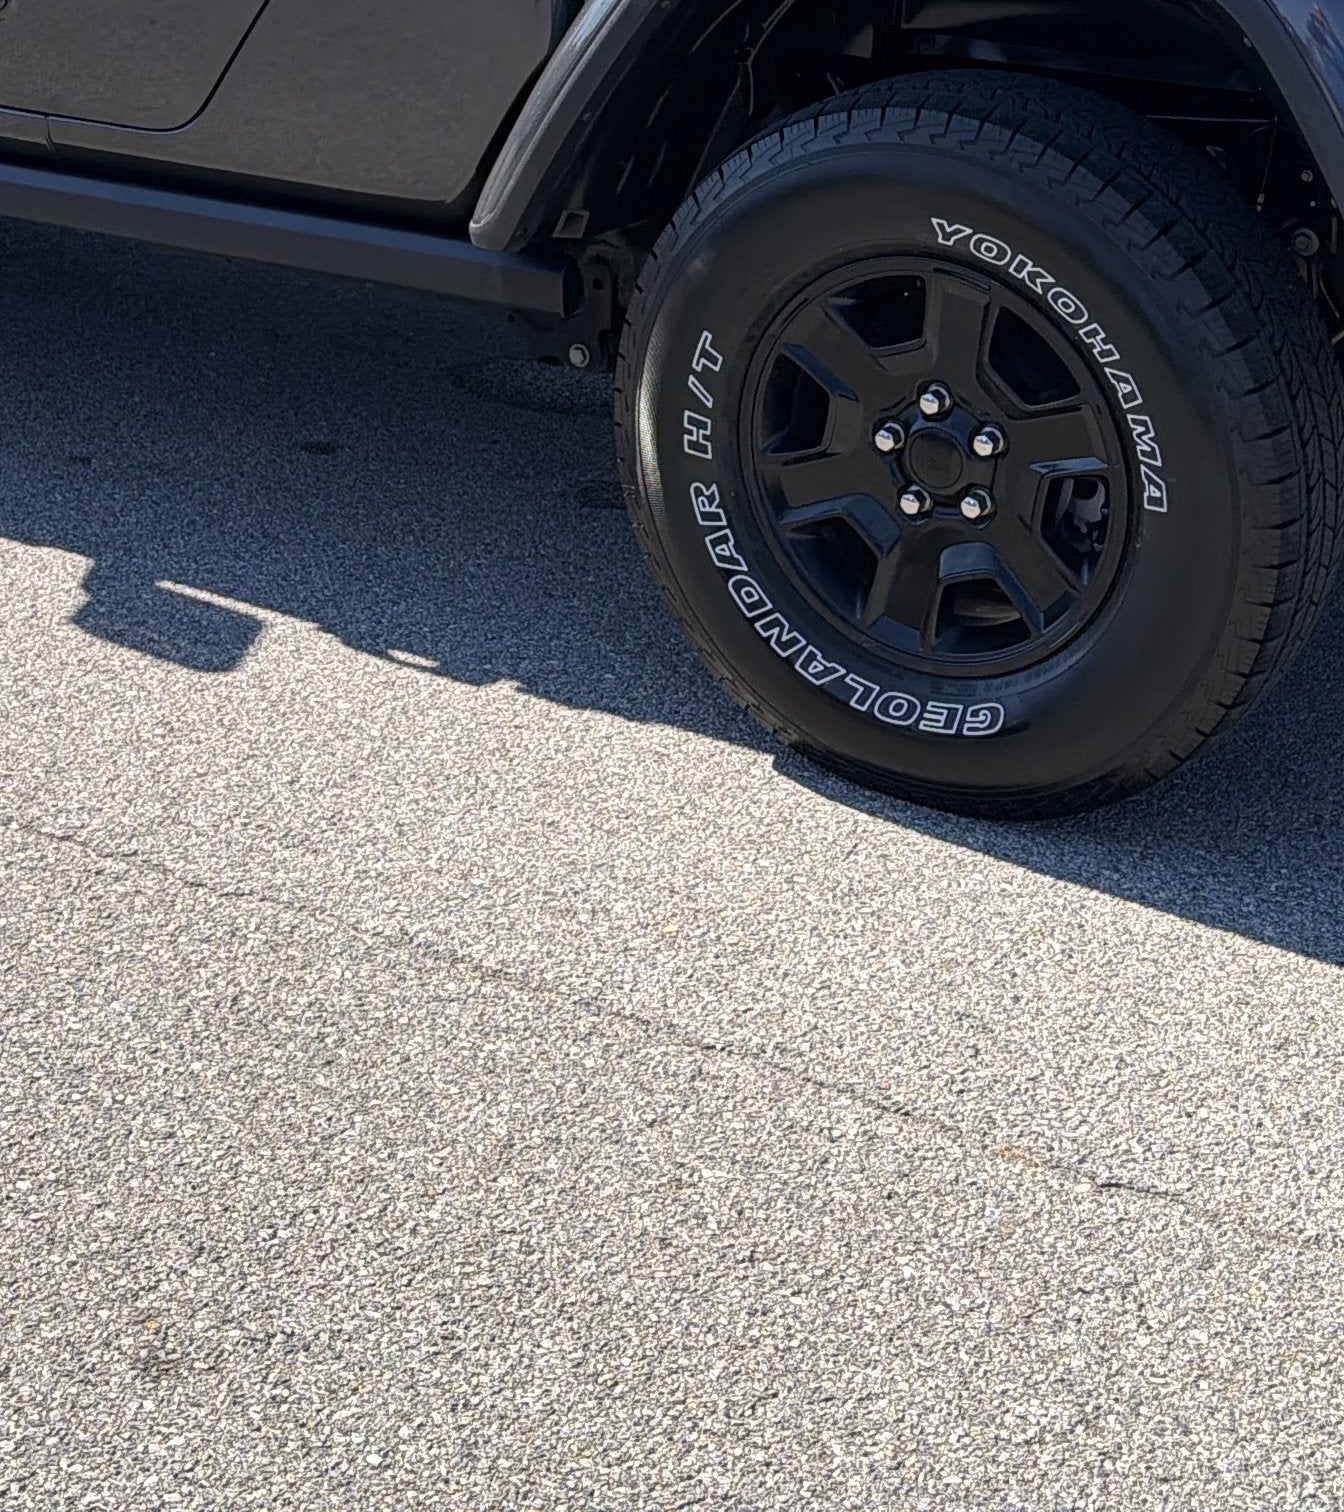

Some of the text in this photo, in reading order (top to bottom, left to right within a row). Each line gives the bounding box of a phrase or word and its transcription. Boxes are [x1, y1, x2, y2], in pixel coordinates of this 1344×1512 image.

[683, 330, 1005, 736] GEOLANDAR H/T
[931, 217, 1167, 512] YOKOHAMA
